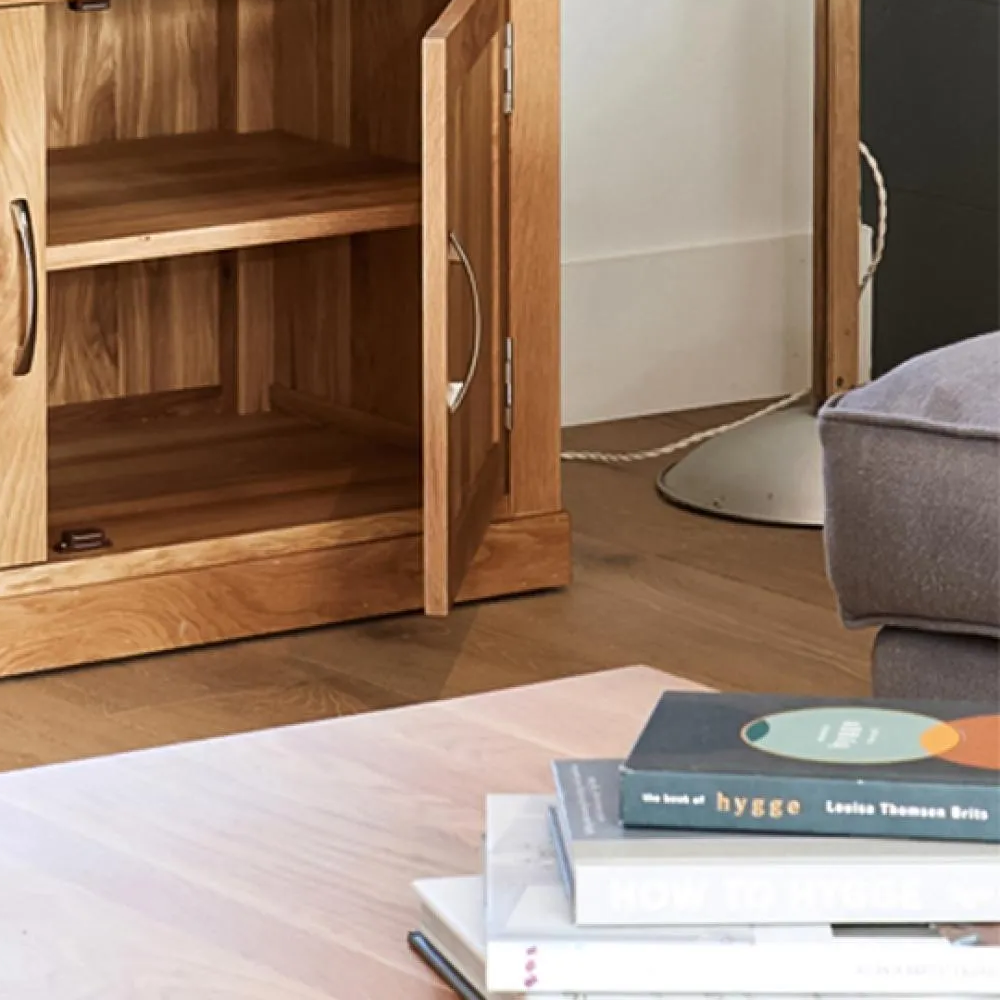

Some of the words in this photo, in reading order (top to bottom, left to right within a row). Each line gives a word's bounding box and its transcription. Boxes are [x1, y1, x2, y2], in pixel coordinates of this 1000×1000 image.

[641, 792, 660, 804] the
[663, 792, 690, 805] book
[692, 794, 706, 806] of
[716, 790, 801, 819] hygge
[608, 877, 709, 911] HOW
[724, 877, 774, 911] TO
